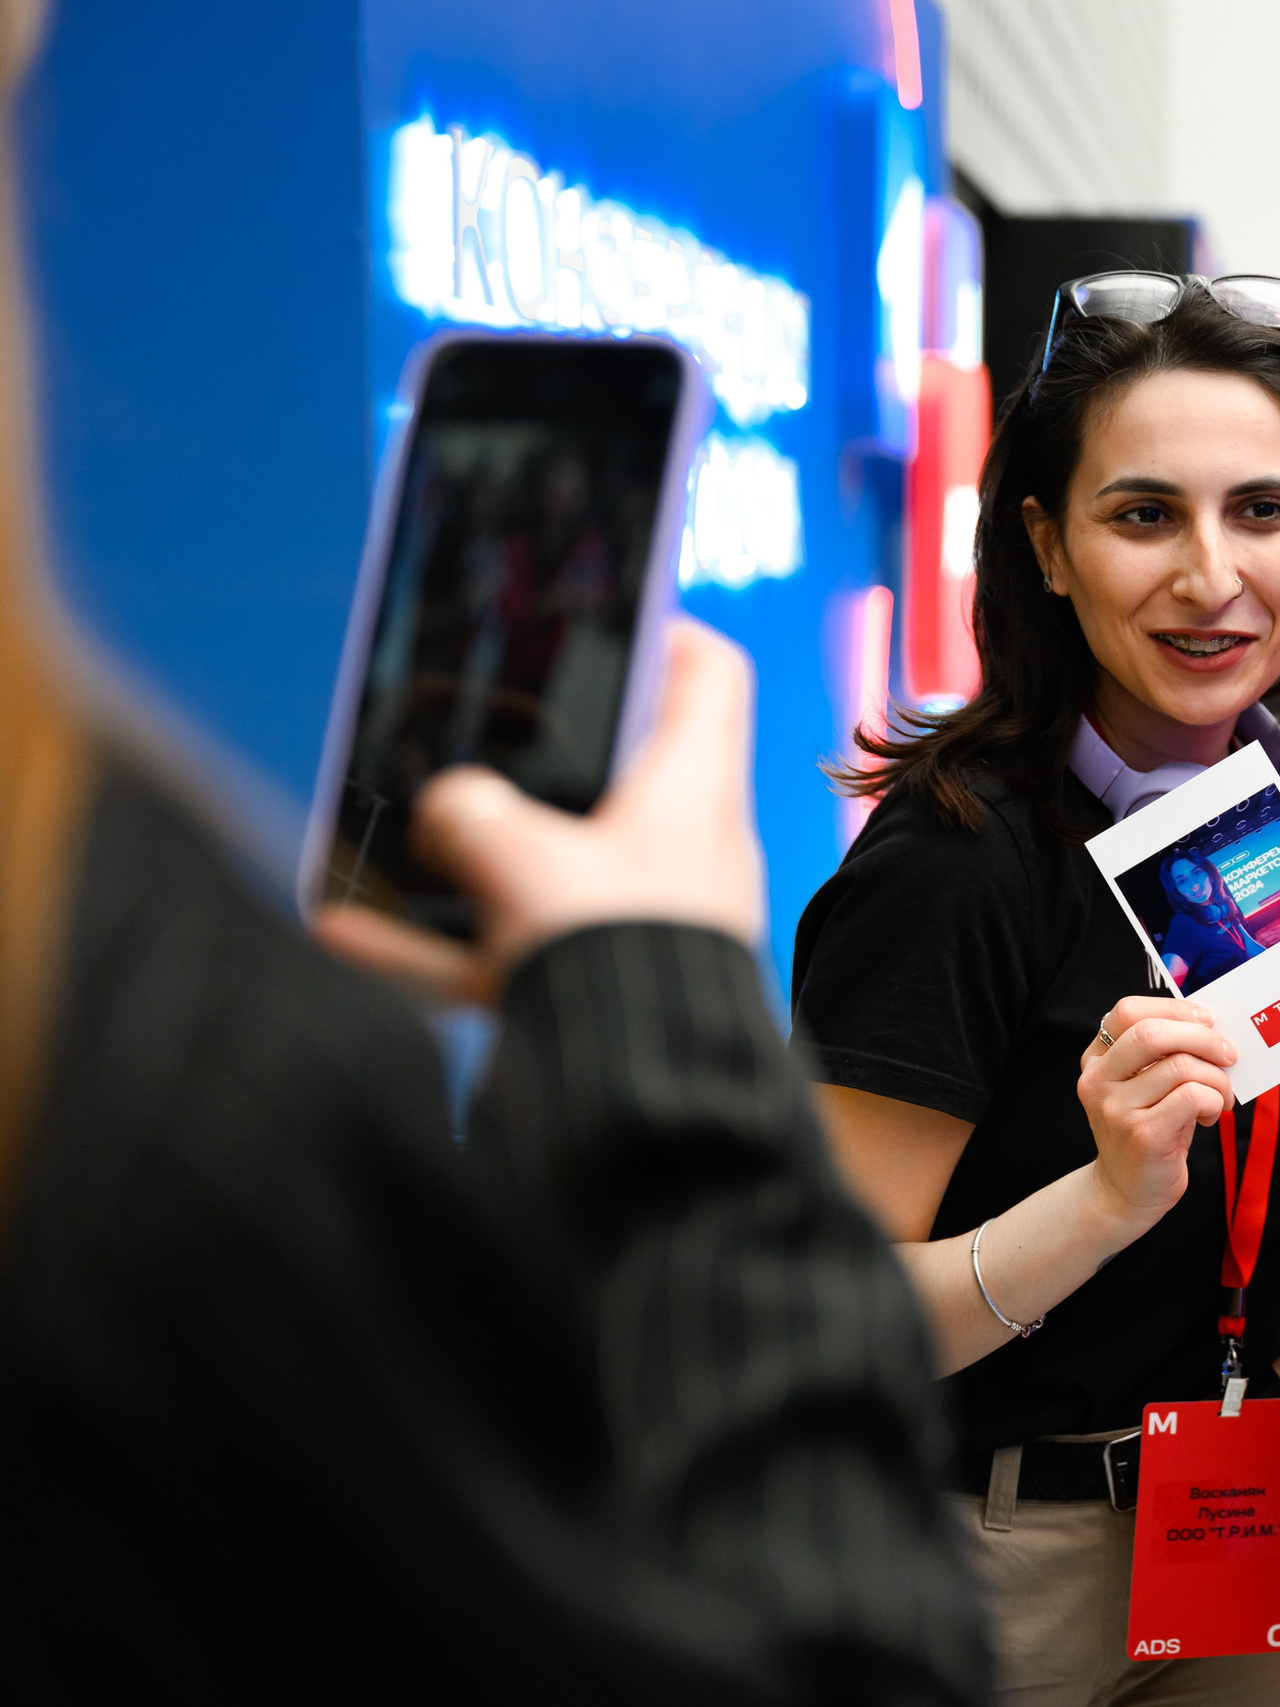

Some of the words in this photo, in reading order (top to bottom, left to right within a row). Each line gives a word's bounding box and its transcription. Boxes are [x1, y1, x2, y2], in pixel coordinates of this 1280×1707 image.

[1233, 880, 1264, 902] 2024
[1189, 1487, 1266, 1500] Восканян
[1198, 1507, 1255, 1522] Лусине
[1166, 1528, 1205, 1541] ООО
[1134, 1638, 1181, 1656] ADS
